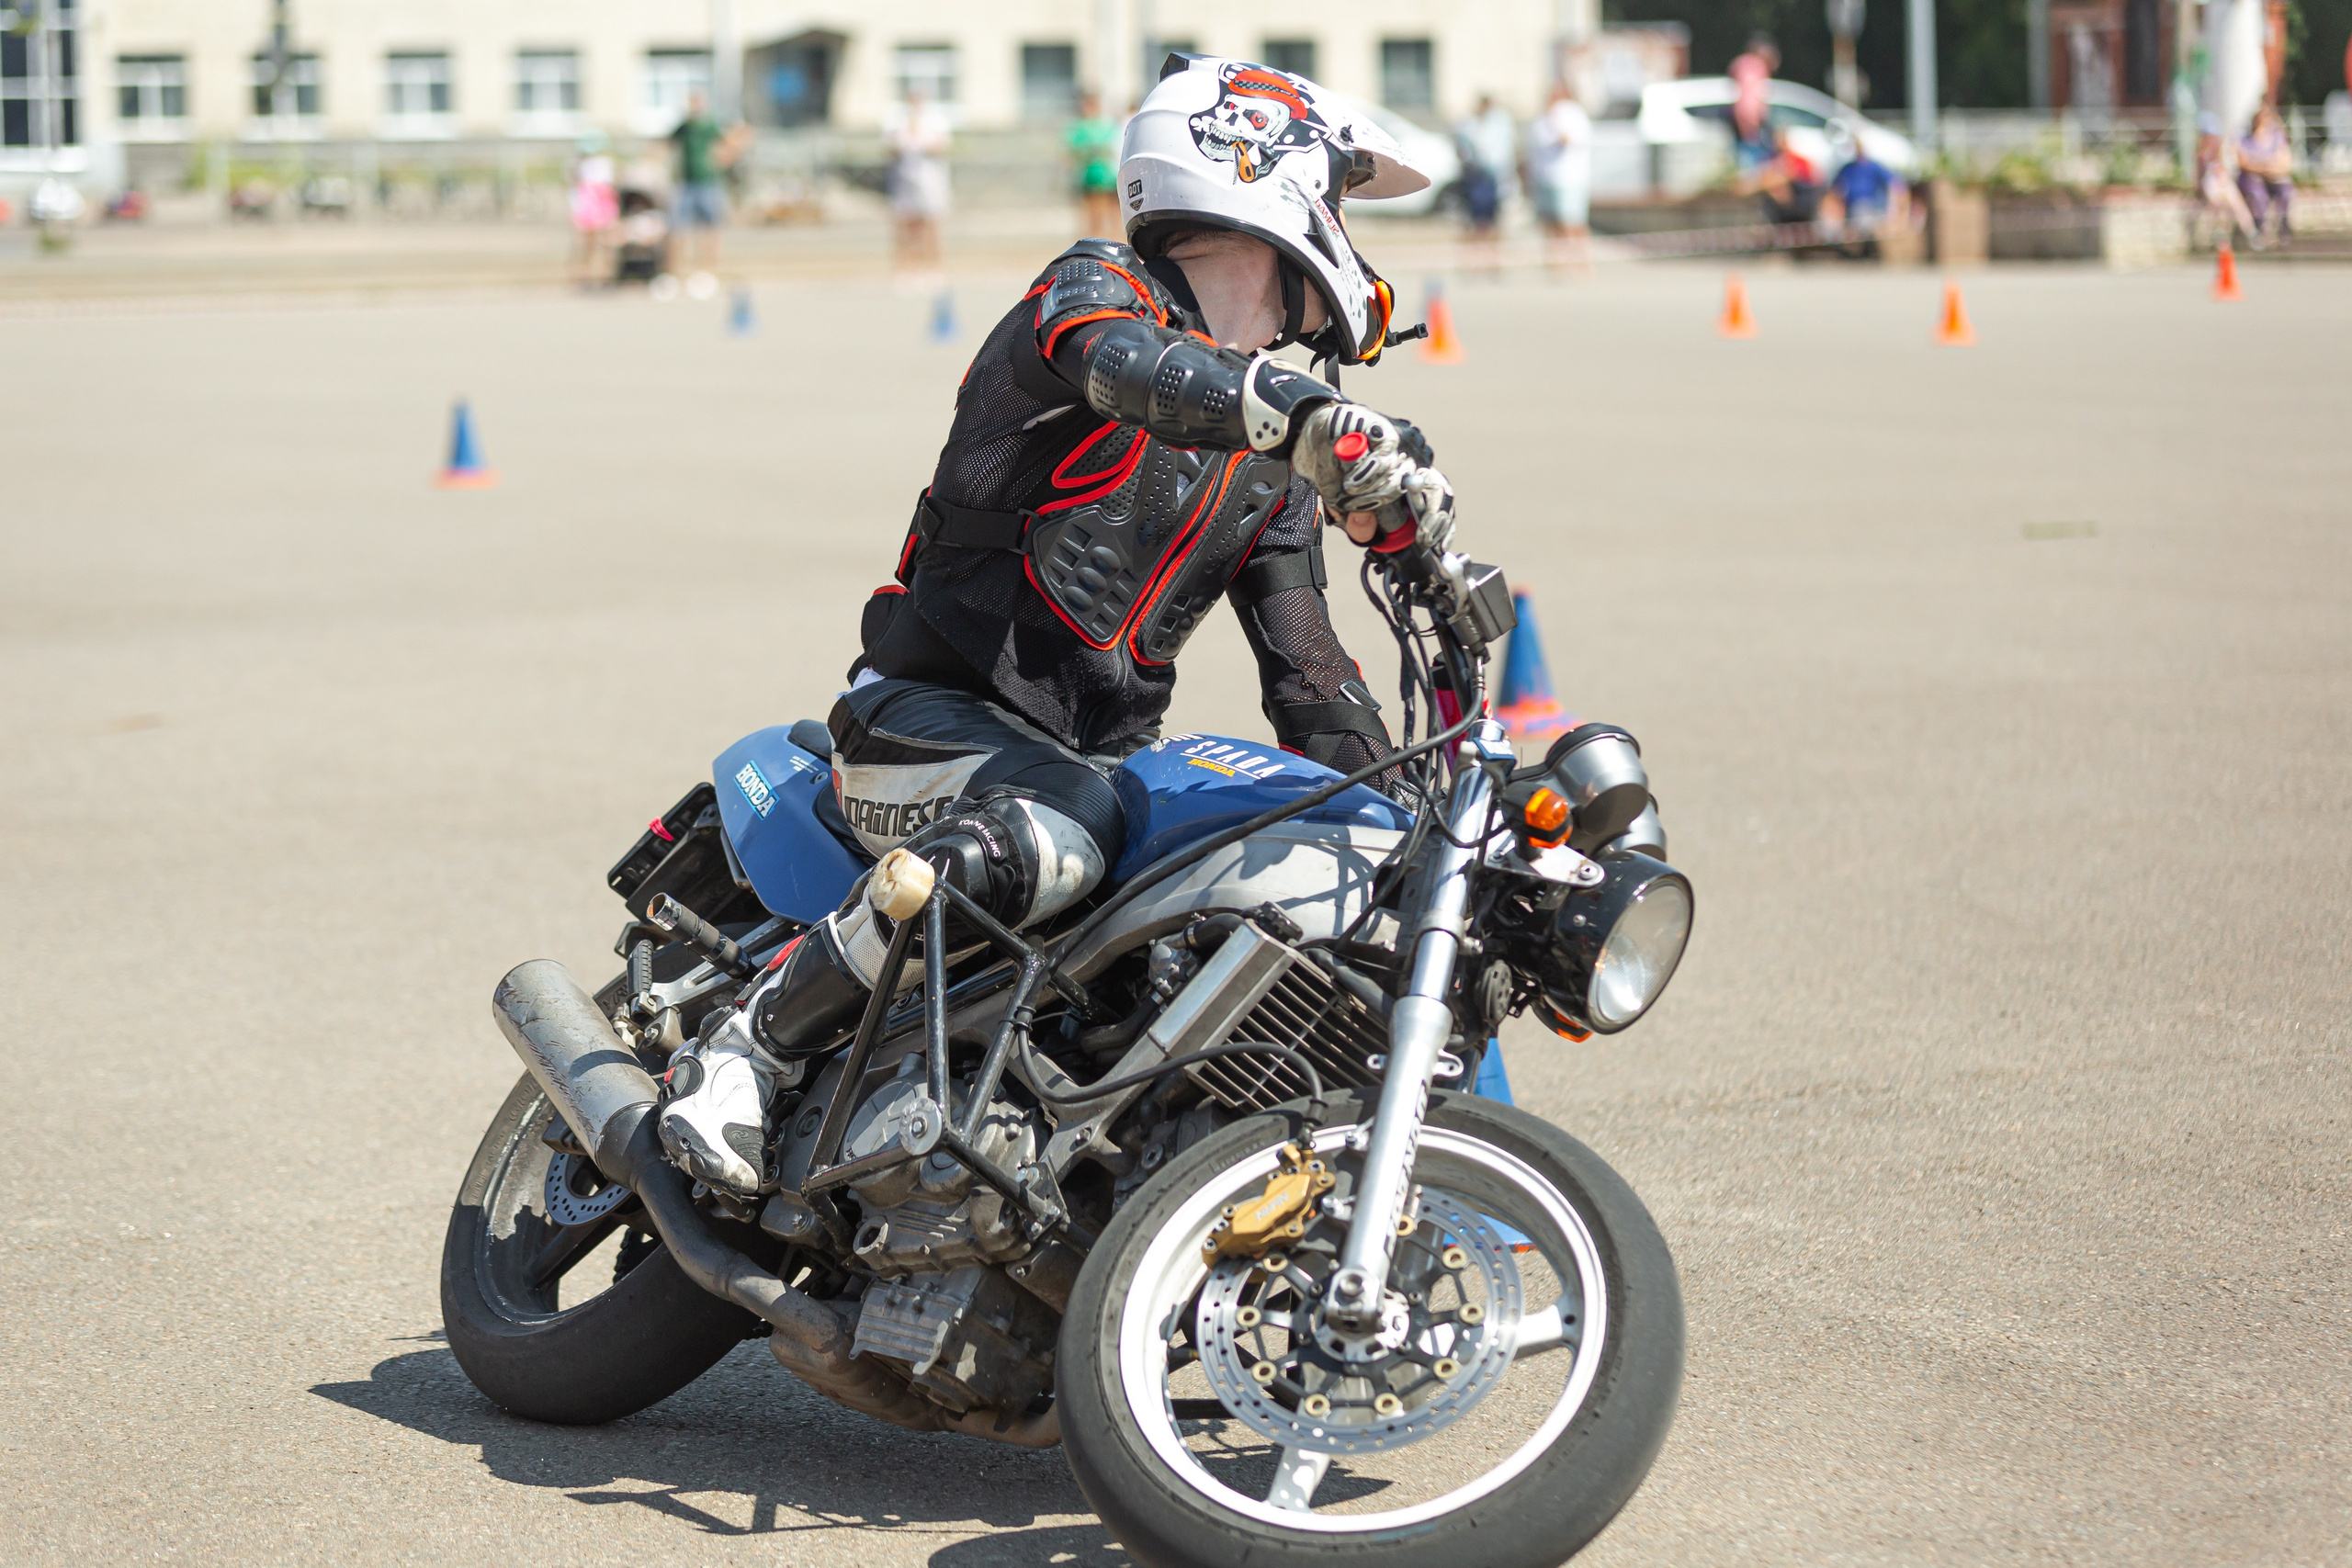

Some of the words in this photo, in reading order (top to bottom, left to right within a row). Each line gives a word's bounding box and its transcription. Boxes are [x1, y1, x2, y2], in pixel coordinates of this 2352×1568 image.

[1184, 740, 1286, 779] SPADA
[1187, 758, 1237, 778] HONDA
[735, 762, 776, 818] HONDA
